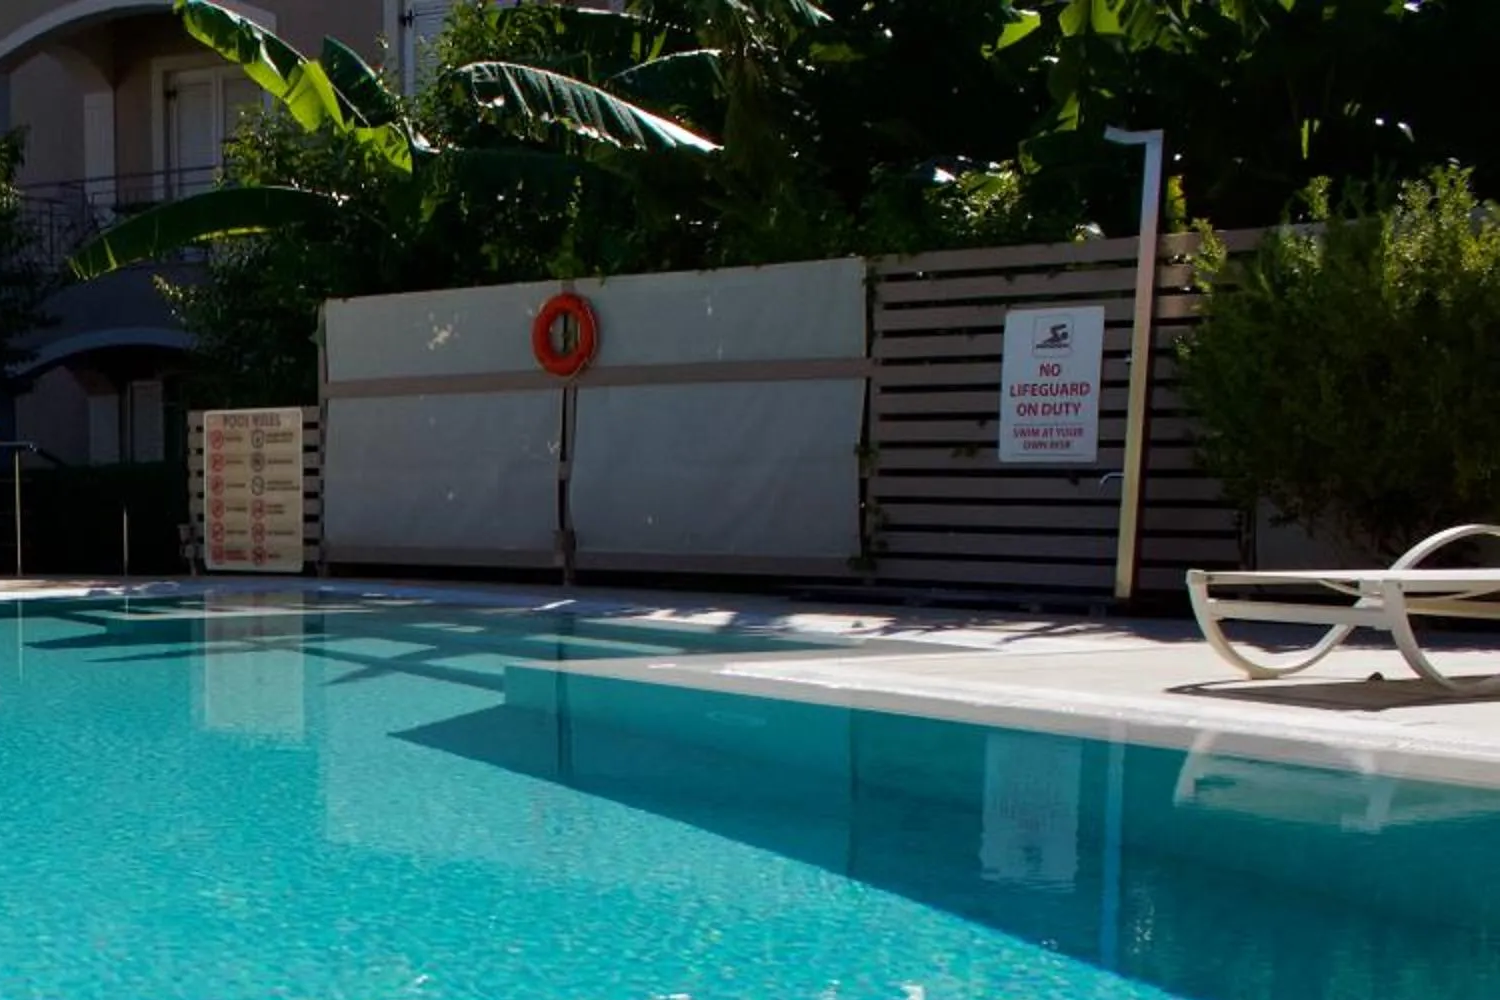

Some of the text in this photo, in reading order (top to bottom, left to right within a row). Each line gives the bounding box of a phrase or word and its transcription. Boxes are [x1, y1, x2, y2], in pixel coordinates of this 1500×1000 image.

[1040, 363, 1061, 377] NO
[1010, 382, 1091, 397] LIFEGUARD
[1016, 402, 1081, 417] ON DUTY
[1042, 427, 1053, 437] AT
